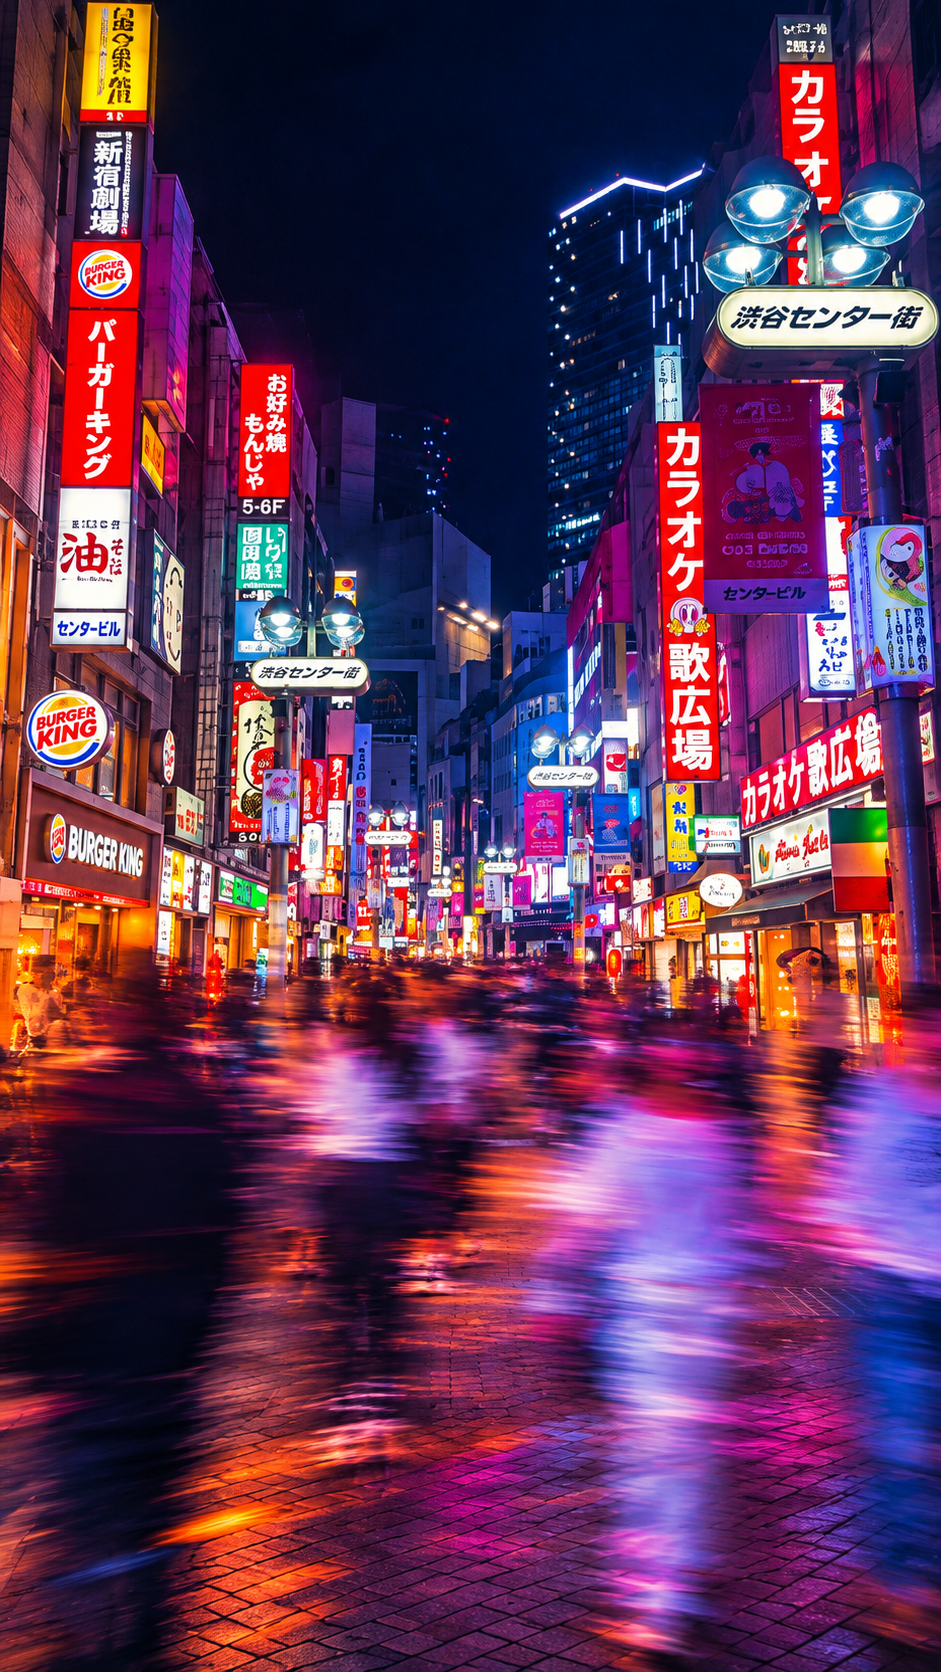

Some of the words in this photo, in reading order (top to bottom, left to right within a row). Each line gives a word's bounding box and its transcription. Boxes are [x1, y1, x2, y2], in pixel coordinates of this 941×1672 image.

[89, 140, 123, 235] 新宿劇場
[84, 260, 124, 276] BURGER
[85, 267, 126, 289] KING
[730, 305, 924, 330] 渋谷センター街
[265, 373, 287, 453] お好み焼
[243, 413, 264, 491] もんじゃ
[242, 499, 285, 515] 5-6F
[666, 428, 704, 592] カラオケ
[60, 532, 109, 574] 油
[57, 620, 121, 637] センタービル
[258, 666, 362, 680] 渋谷センター街
[35, 706, 97, 731] BURGER
[668, 642, 713, 771] 歌広場
[36, 719, 97, 751] KING
[742, 711, 884, 825] カラオケ歌広場
[67, 824, 118, 871] BURGER
[118, 842, 144, 877] KING
